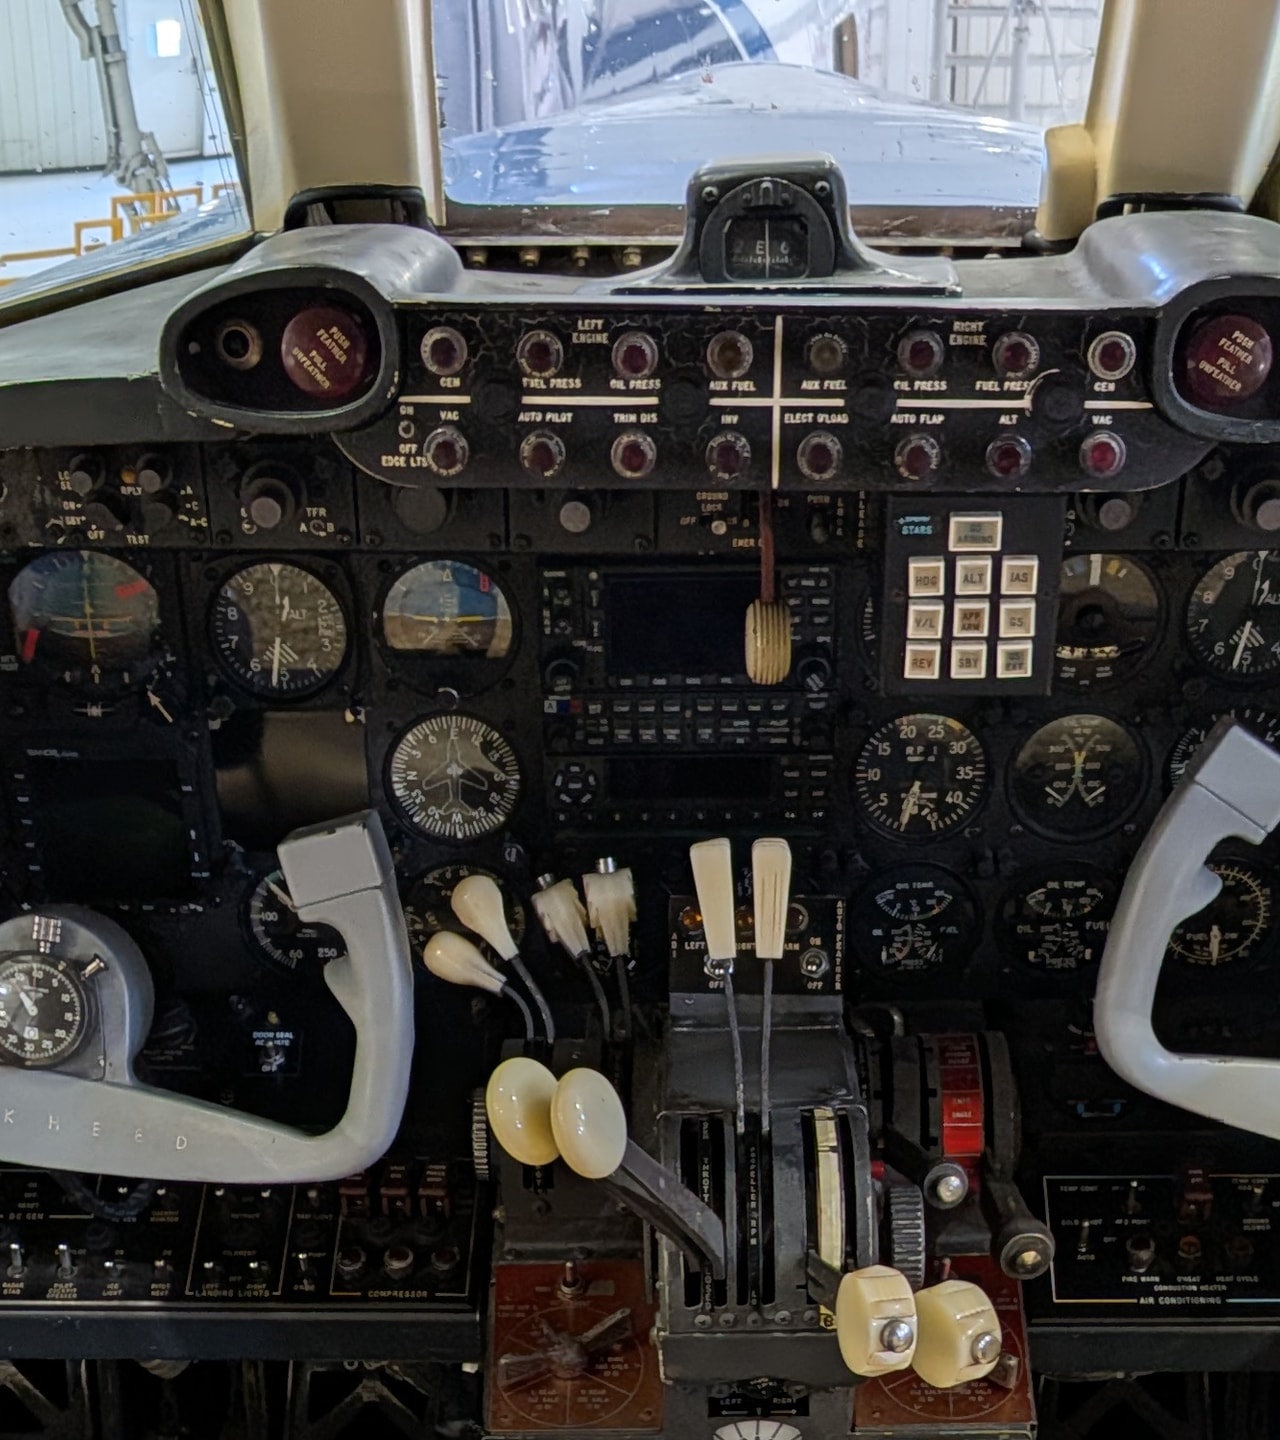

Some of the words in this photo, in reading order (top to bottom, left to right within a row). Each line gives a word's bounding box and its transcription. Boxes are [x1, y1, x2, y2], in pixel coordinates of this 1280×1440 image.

[577, 318, 603, 332] LEFT
[953, 320, 984, 333] RIGHT
[328, 325, 351, 350] PUSH
[572, 331, 609, 345] ENGINE
[948, 333, 987, 347] ENGINE
[1231, 330, 1255, 350] PUSH
[316, 328, 348, 365] FEATHER
[1218, 338, 1254, 365] FEATHER
[308, 349, 329, 372] PULL
[1215, 356, 1237, 375] PULL
[291, 346, 331, 390] UNFEATHER
[1198, 360, 1242, 392] UNFEATHER
[439, 377, 460, 389] GEN
[522, 377, 544, 389] FUEL
[545, 377, 582, 390] PRESS
[609, 378, 627, 390] OIL
[628, 378, 662, 390] PRESS
[708, 380, 730, 392] AUX
[731, 380, 756, 392] FUEL
[800, 379, 821, 391] AUX
[823, 379, 847, 391] FUEL
[893, 379, 912, 392] OIL
[914, 379, 948, 392] PRESS
[975, 380, 1001, 392] FUEL
[1002, 380, 1034, 392] PRESS
[439, 410, 461, 422] VAC
[518, 411, 539, 423] AUTO
[540, 411, 573, 424] PILOT
[613, 412, 636, 424] TRIM
[637, 412, 658, 424] DIS
[721, 413, 739, 425] INV
[784, 412, 814, 424] ELECT
[890, 413, 913, 425] AUTO
[915, 413, 945, 426] FLAP
[998, 413, 1020, 426] ALT
[1091, 414, 1114, 426] VAC
[398, 443, 419, 455] OFF
[381, 455, 409, 468] EDGE
[305, 506, 327, 518] TFR
[901, 525, 933, 535] STARS
[125, 534, 150, 546] TEST
[914, 574, 938, 587] HDG
[962, 572, 984, 584] ALT
[1009, 572, 1029, 584] IAS
[227, 606, 239, 621] 8
[287, 608, 308, 621] ALT
[914, 617, 936, 629] V/L
[1213, 641, 1226, 656] 6
[249, 658, 262, 672] 6
[911, 658, 933, 670] REV
[957, 658, 979, 669] SBY
[899, 725, 918, 739] 20
[927, 724, 945, 739] 25
[877, 742, 891, 756] 15
[948, 741, 968, 755] 30
[867, 768, 881, 781] 10
[955, 766, 974, 780] 35
[878, 792, 889, 807] 5
[945, 790, 964, 804] 40
[260, 911, 279, 923] 100
[316, 946, 338, 959] 250
[684, 941, 706, 951] LEFT
[274, 1030, 295, 1040] SEAL
[367, 1290, 429, 1299] COMPRESSOR
[1138, 1296, 1156, 1305] AIR
[1157, 1296, 1222, 1305] CONDITIONING
